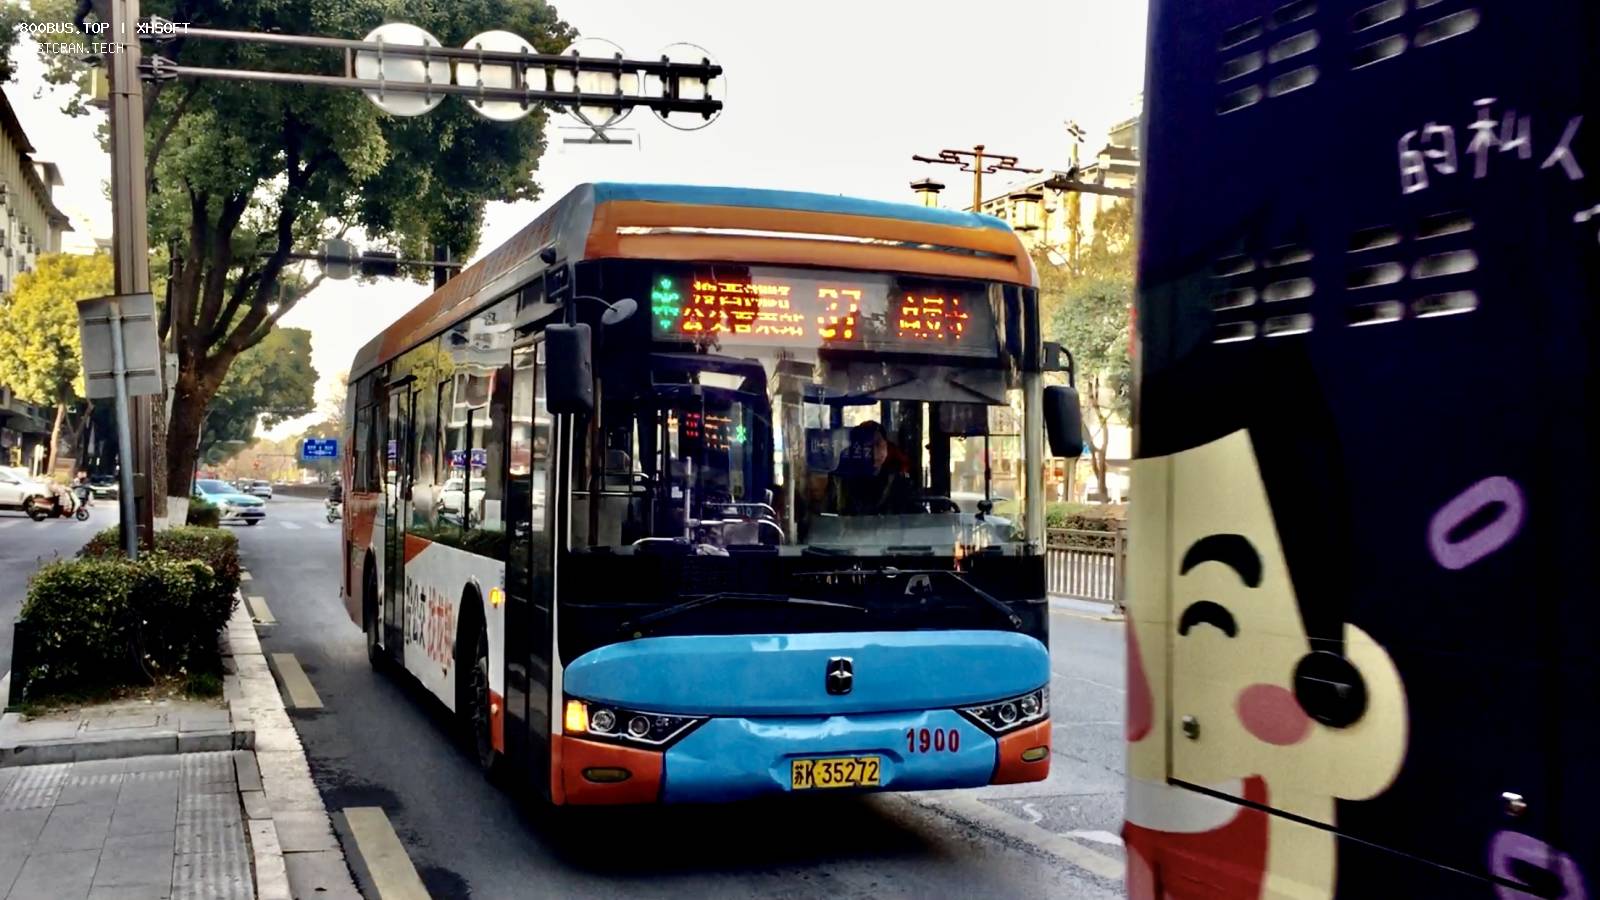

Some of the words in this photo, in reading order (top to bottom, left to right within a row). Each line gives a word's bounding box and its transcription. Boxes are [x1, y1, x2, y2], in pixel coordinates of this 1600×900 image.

[1397, 97, 1584, 194] 的私人
[817, 287, 862, 340] 37
[906, 728, 960, 753] 1900
